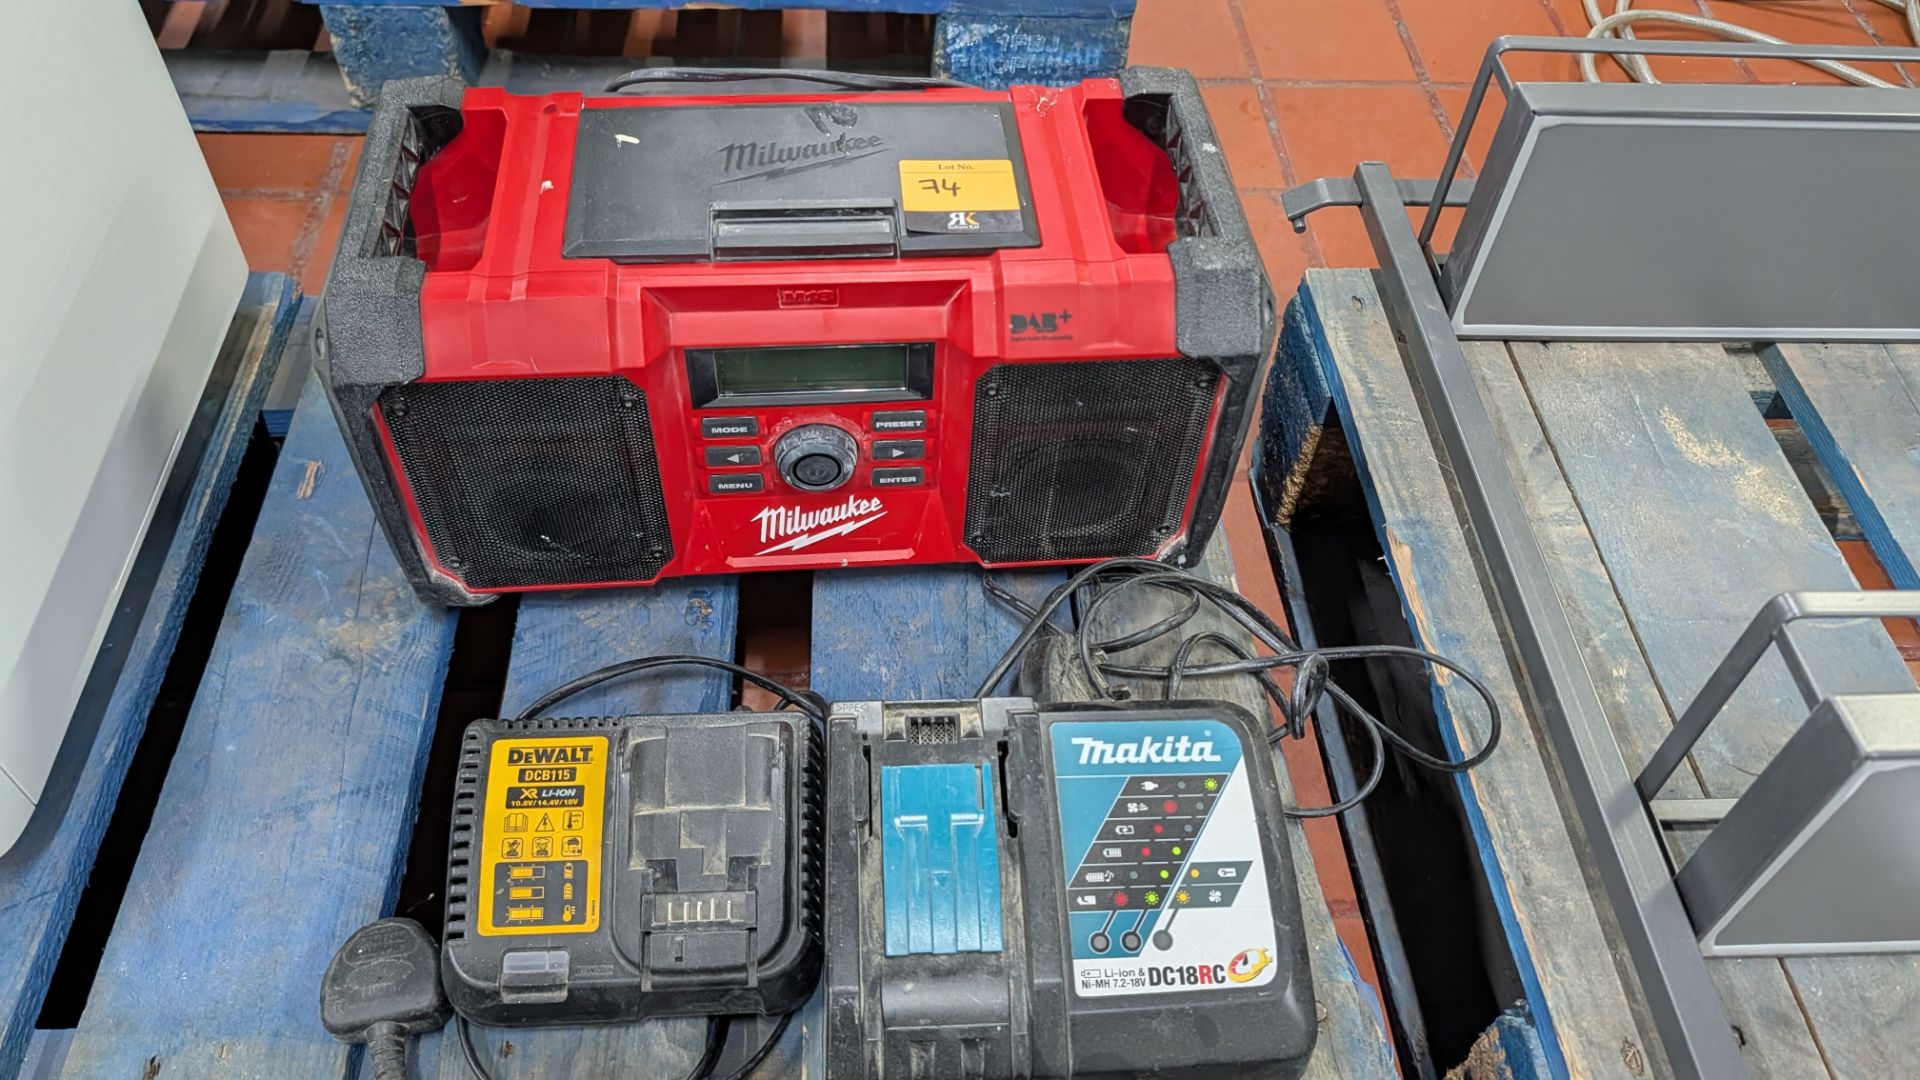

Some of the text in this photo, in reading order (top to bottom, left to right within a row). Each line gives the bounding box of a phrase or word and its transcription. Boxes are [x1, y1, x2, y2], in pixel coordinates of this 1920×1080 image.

[918, 178, 961, 197] 74
[711, 426, 748, 434] MODE
[875, 420, 923, 429] PRESET
[718, 482, 753, 490] MENU
[879, 476, 917, 485] ENTER
[751, 495, 883, 543] Milwaukee
[1071, 735, 1221, 765] Makita
[524, 770, 571, 781] DCB115
[520, 788, 577, 799] XR LI-ION
[1104, 968, 1145, 977] Li-ion &
[1148, 964, 1226, 986] DC18RC
[1081, 978, 1146, 989] Ni-MH 7.2-18V
